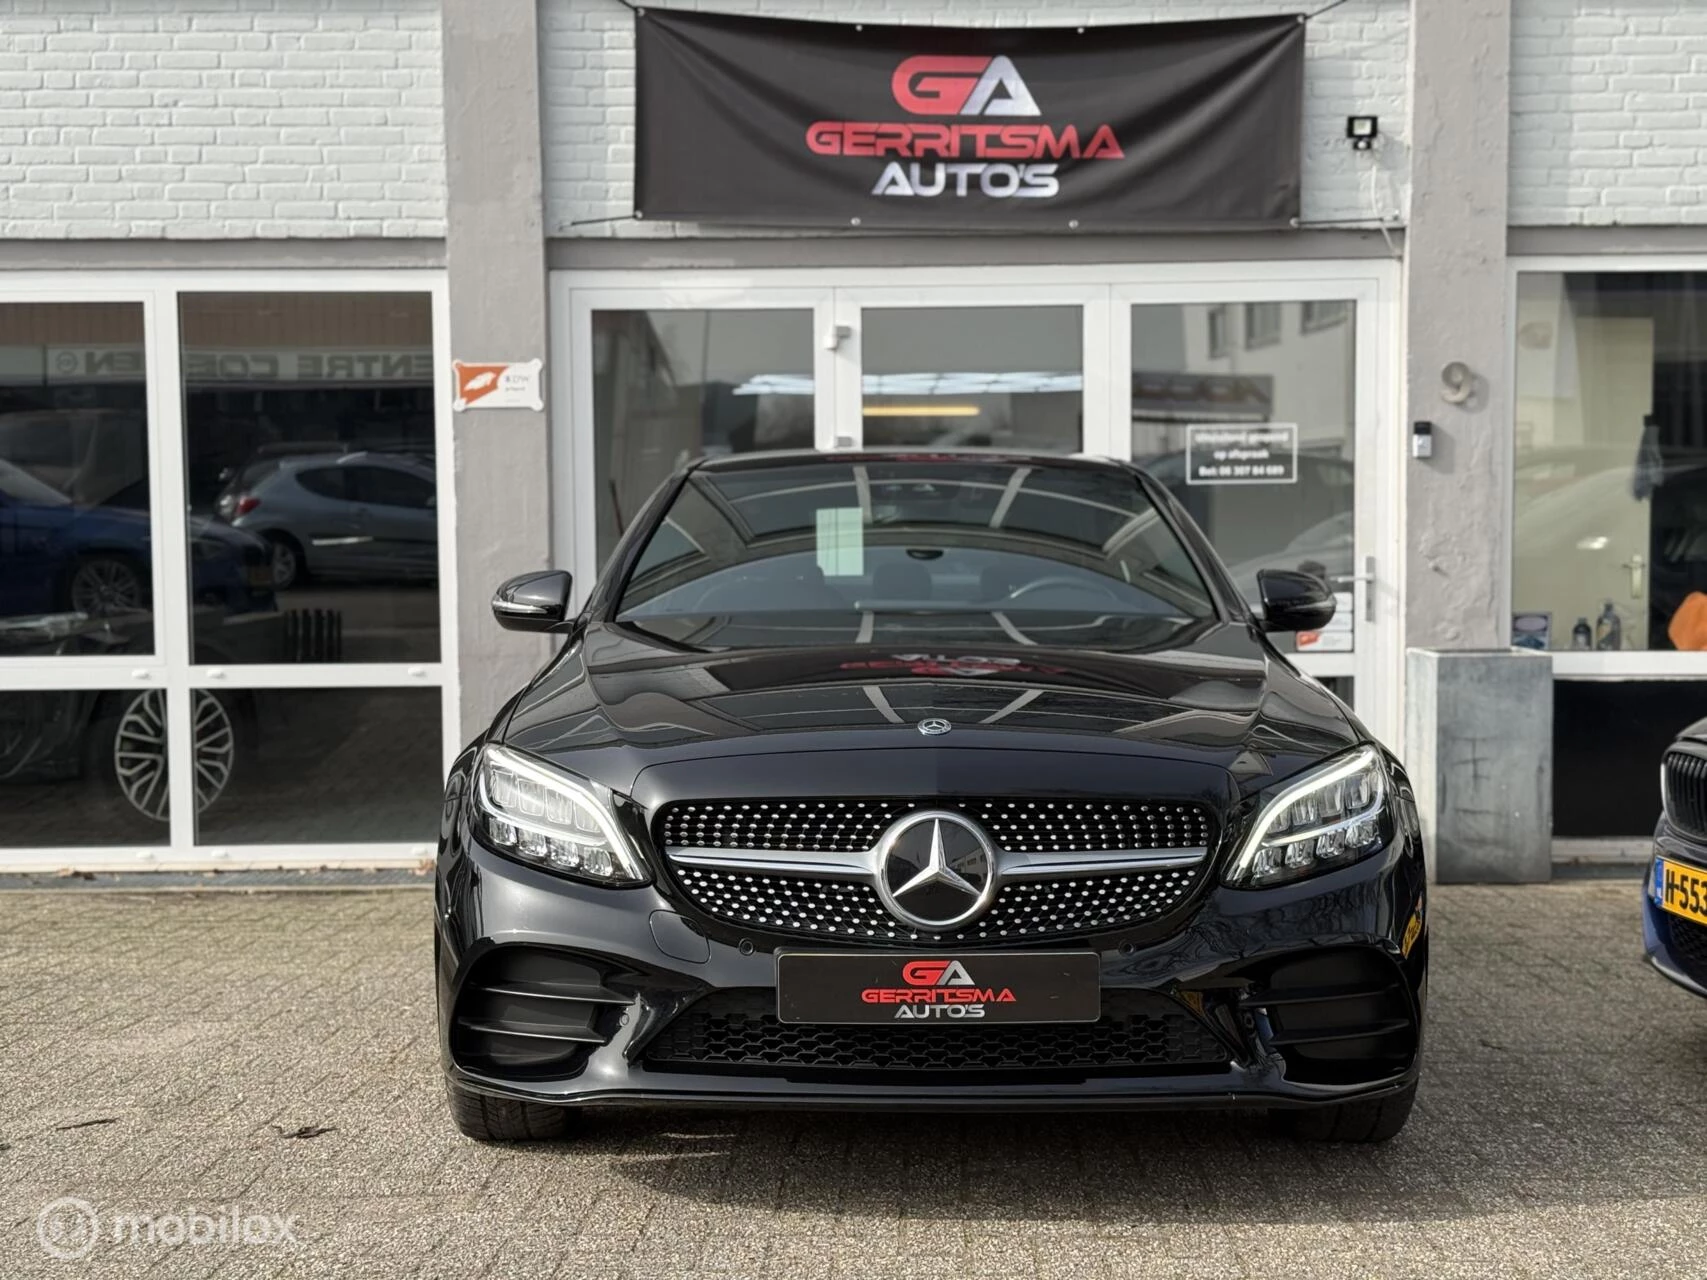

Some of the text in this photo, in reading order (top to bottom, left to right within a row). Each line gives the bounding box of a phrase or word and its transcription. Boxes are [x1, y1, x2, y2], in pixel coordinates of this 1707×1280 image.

[891, 55, 1042, 116] GA
[805, 121, 1126, 160] GERRITSMA
[871, 161, 1060, 198] AUTO'S
[1441, 361, 1472, 404] 9
[902, 960, 976, 985] GA
[861, 988, 1017, 1003] GERRITSMA
[894, 1004, 985, 1019] AUTO'S
